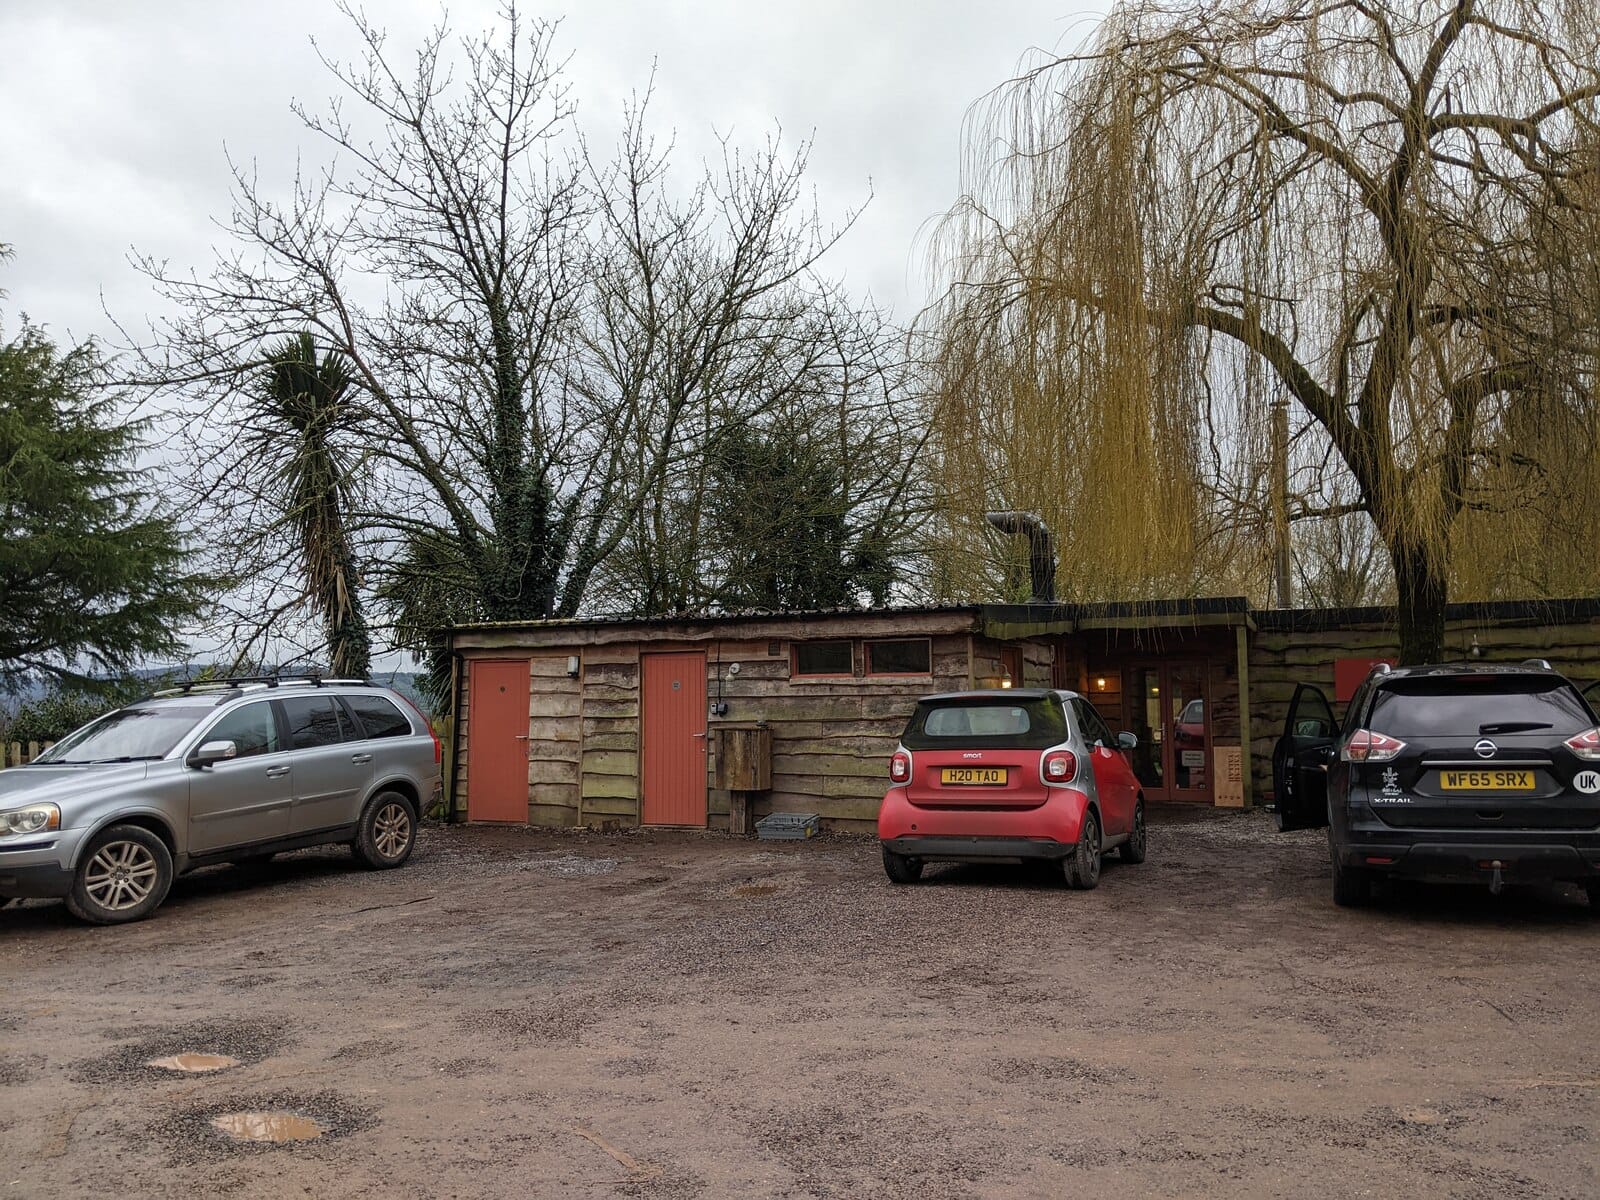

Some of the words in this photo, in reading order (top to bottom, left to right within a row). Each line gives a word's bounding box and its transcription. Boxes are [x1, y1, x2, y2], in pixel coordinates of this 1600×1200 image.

[976, 770, 998, 782] TAO
[1447, 772, 1490, 787] WF65
[1495, 772, 1528, 787] SRX
[1580, 775, 1597, 789] UK
